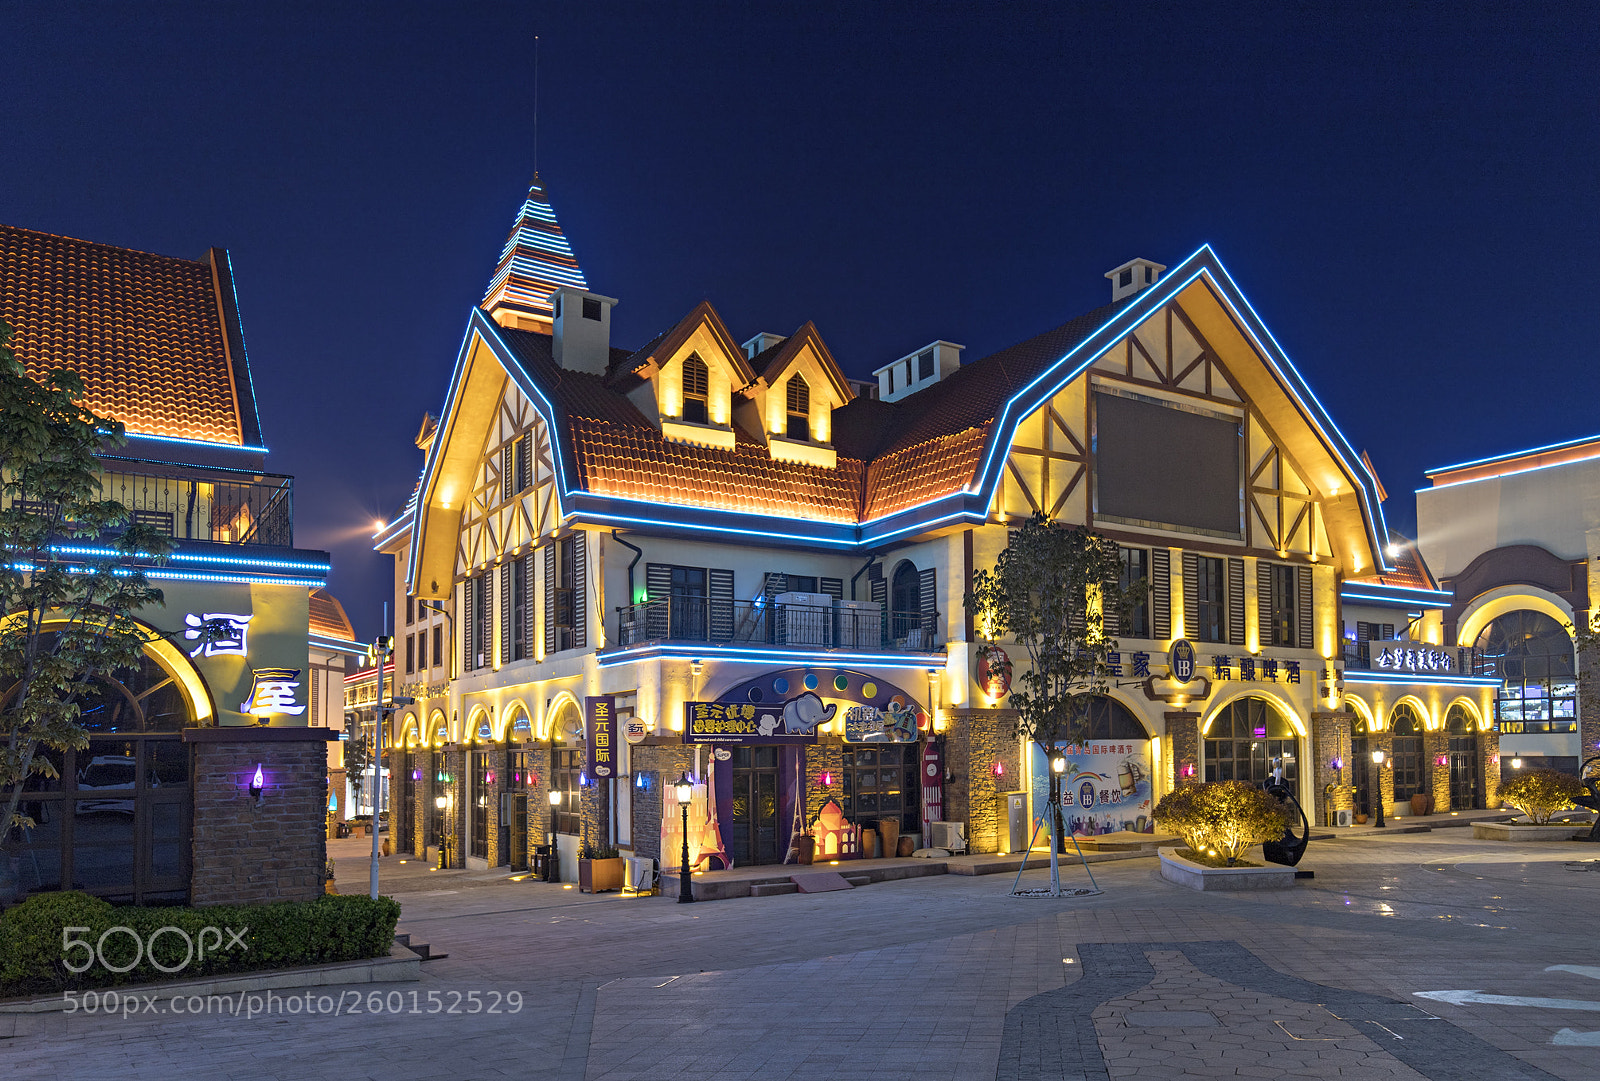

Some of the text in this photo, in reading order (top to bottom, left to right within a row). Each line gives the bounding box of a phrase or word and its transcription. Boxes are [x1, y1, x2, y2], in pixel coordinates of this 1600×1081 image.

[1177, 660, 1190, 677] HB
[1212, 654, 1300, 684] 精酿啤酒
[847, 706, 884, 722] 机器人
[595, 702, 610, 762] 圣元国际
[628, 723, 644, 733] 圣元
[693, 719, 757, 733] 母婴护理中心
[1083, 794, 1092, 806] HB
[1100, 789, 1121, 804] 餐饮
